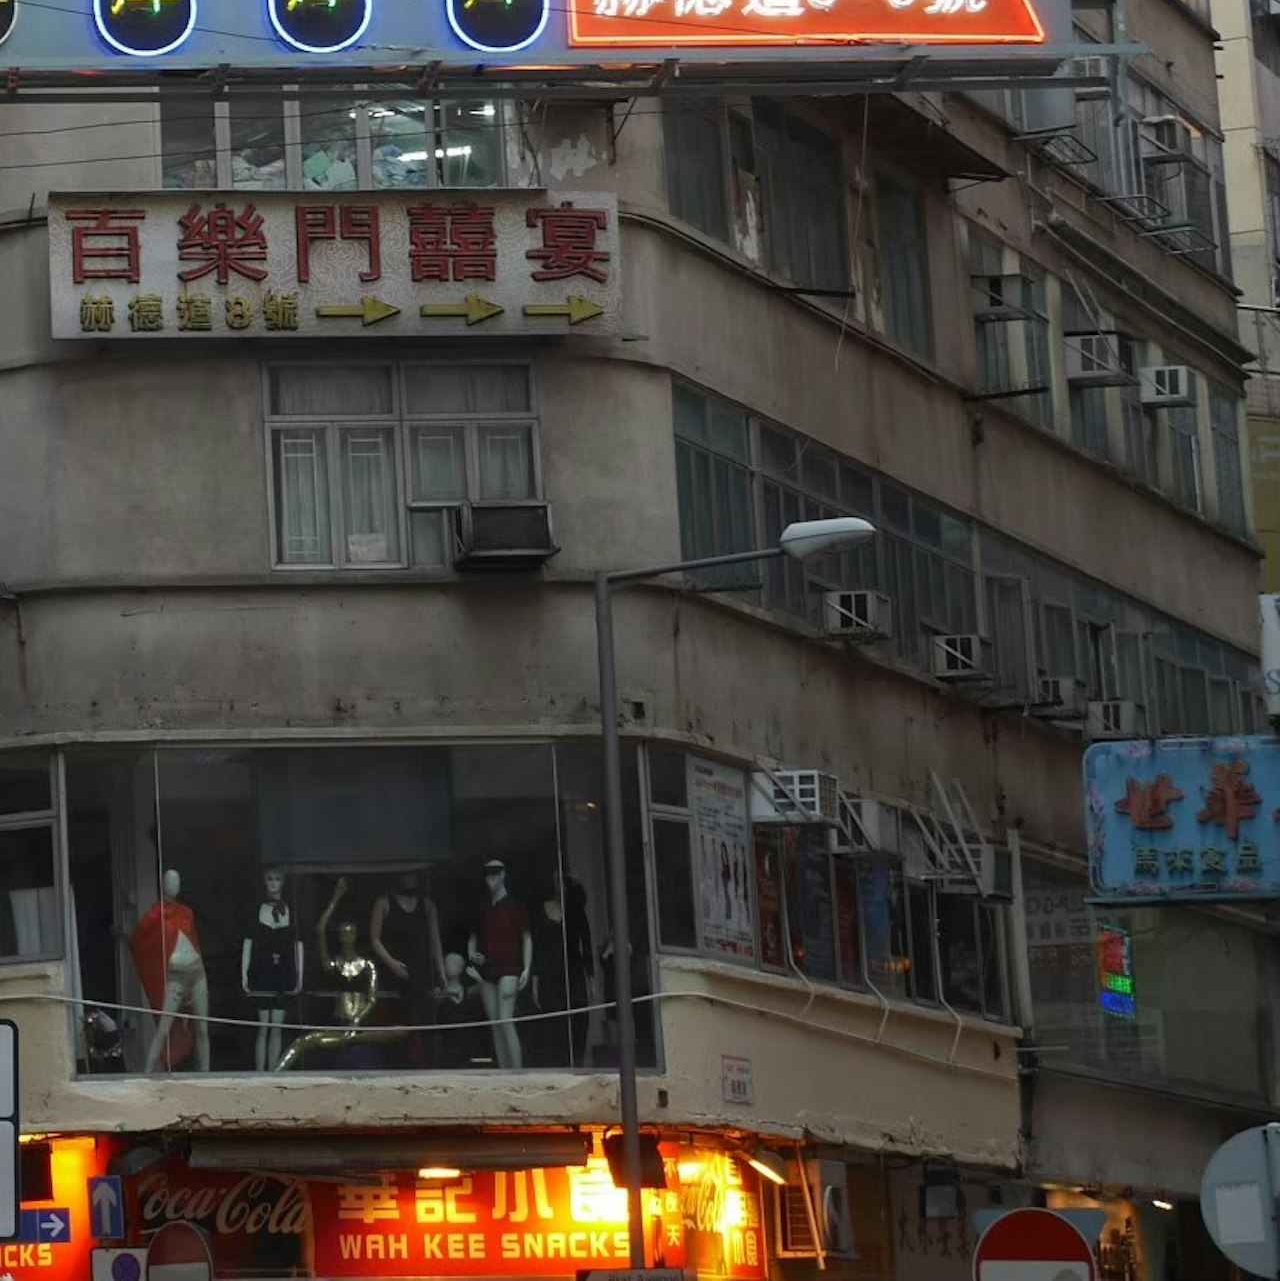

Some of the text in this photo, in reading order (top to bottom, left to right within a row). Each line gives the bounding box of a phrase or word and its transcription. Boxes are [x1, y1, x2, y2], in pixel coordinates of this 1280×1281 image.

[64, 200, 611, 286] 百樂門囍宴
[79, 288, 300, 333] 赫德道8號
[339, 1231, 631, 1260] WAH KEE SNACKS
